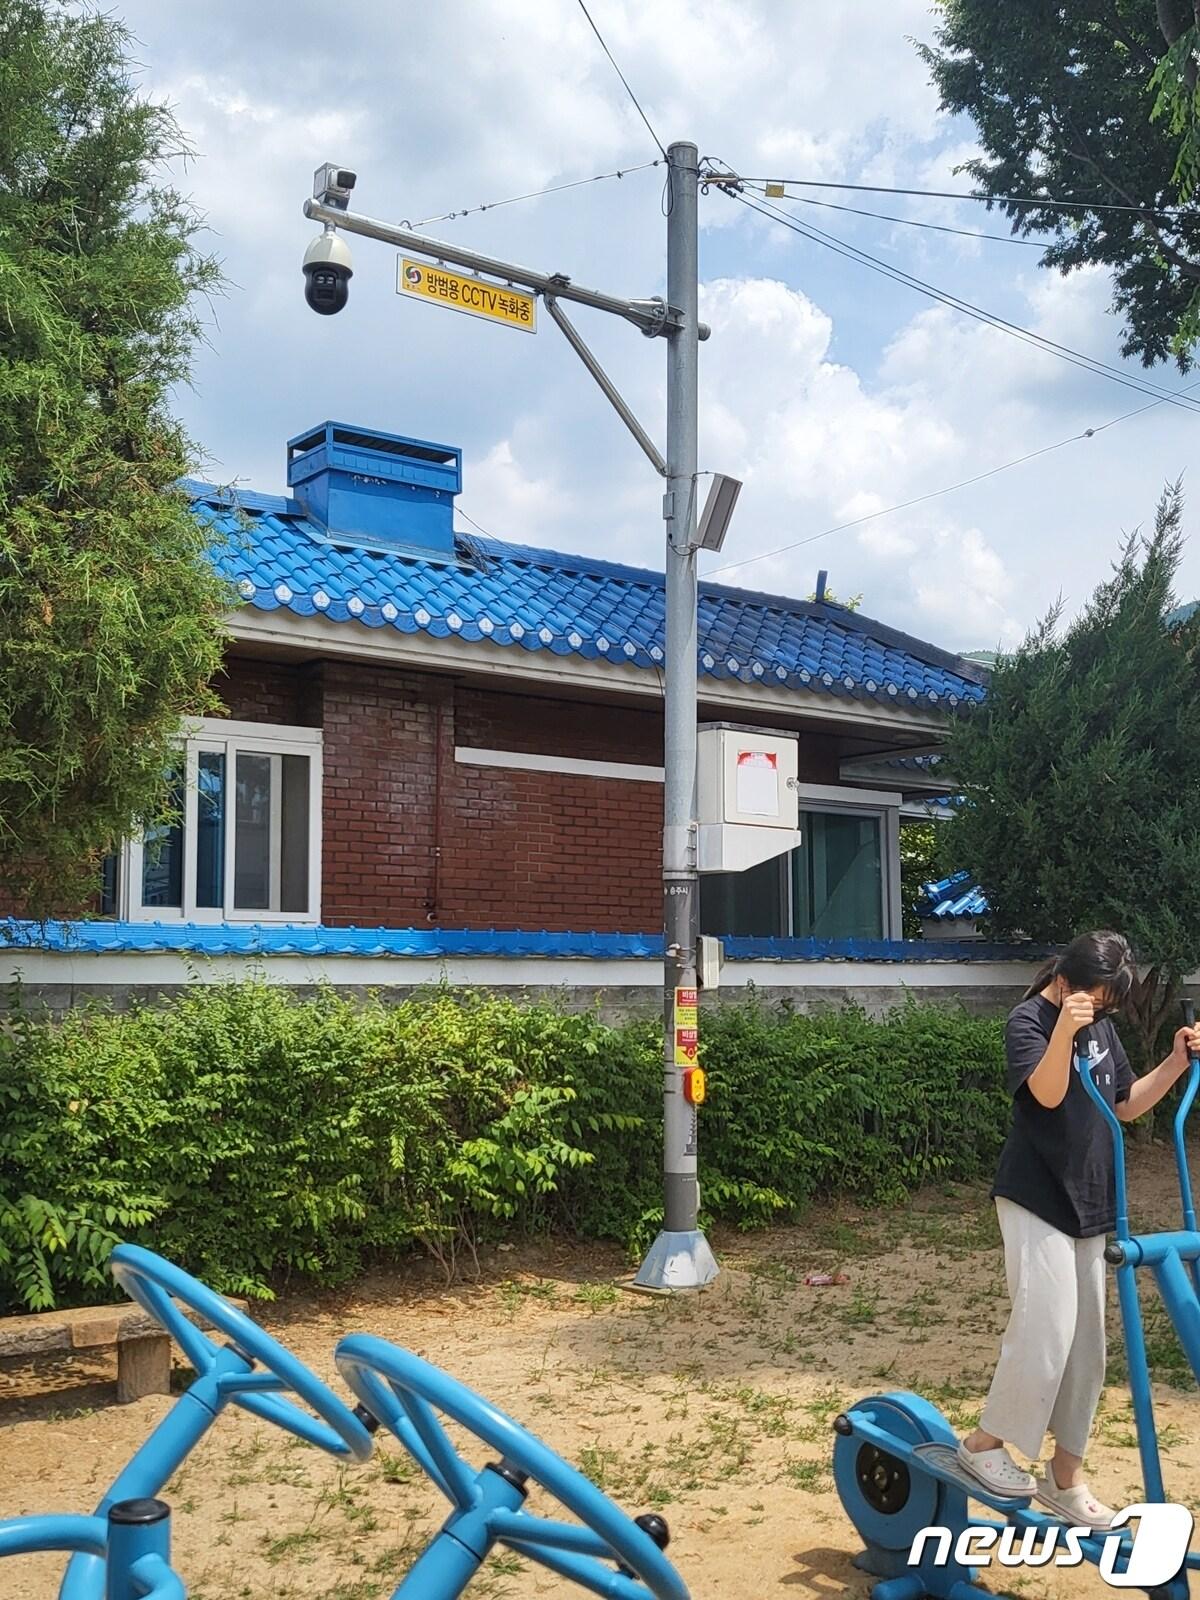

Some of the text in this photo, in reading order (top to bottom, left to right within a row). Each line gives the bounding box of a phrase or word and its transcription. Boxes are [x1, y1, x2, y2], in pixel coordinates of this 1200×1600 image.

[427, 273, 531, 322] 방범용 CCTV 녹화중
